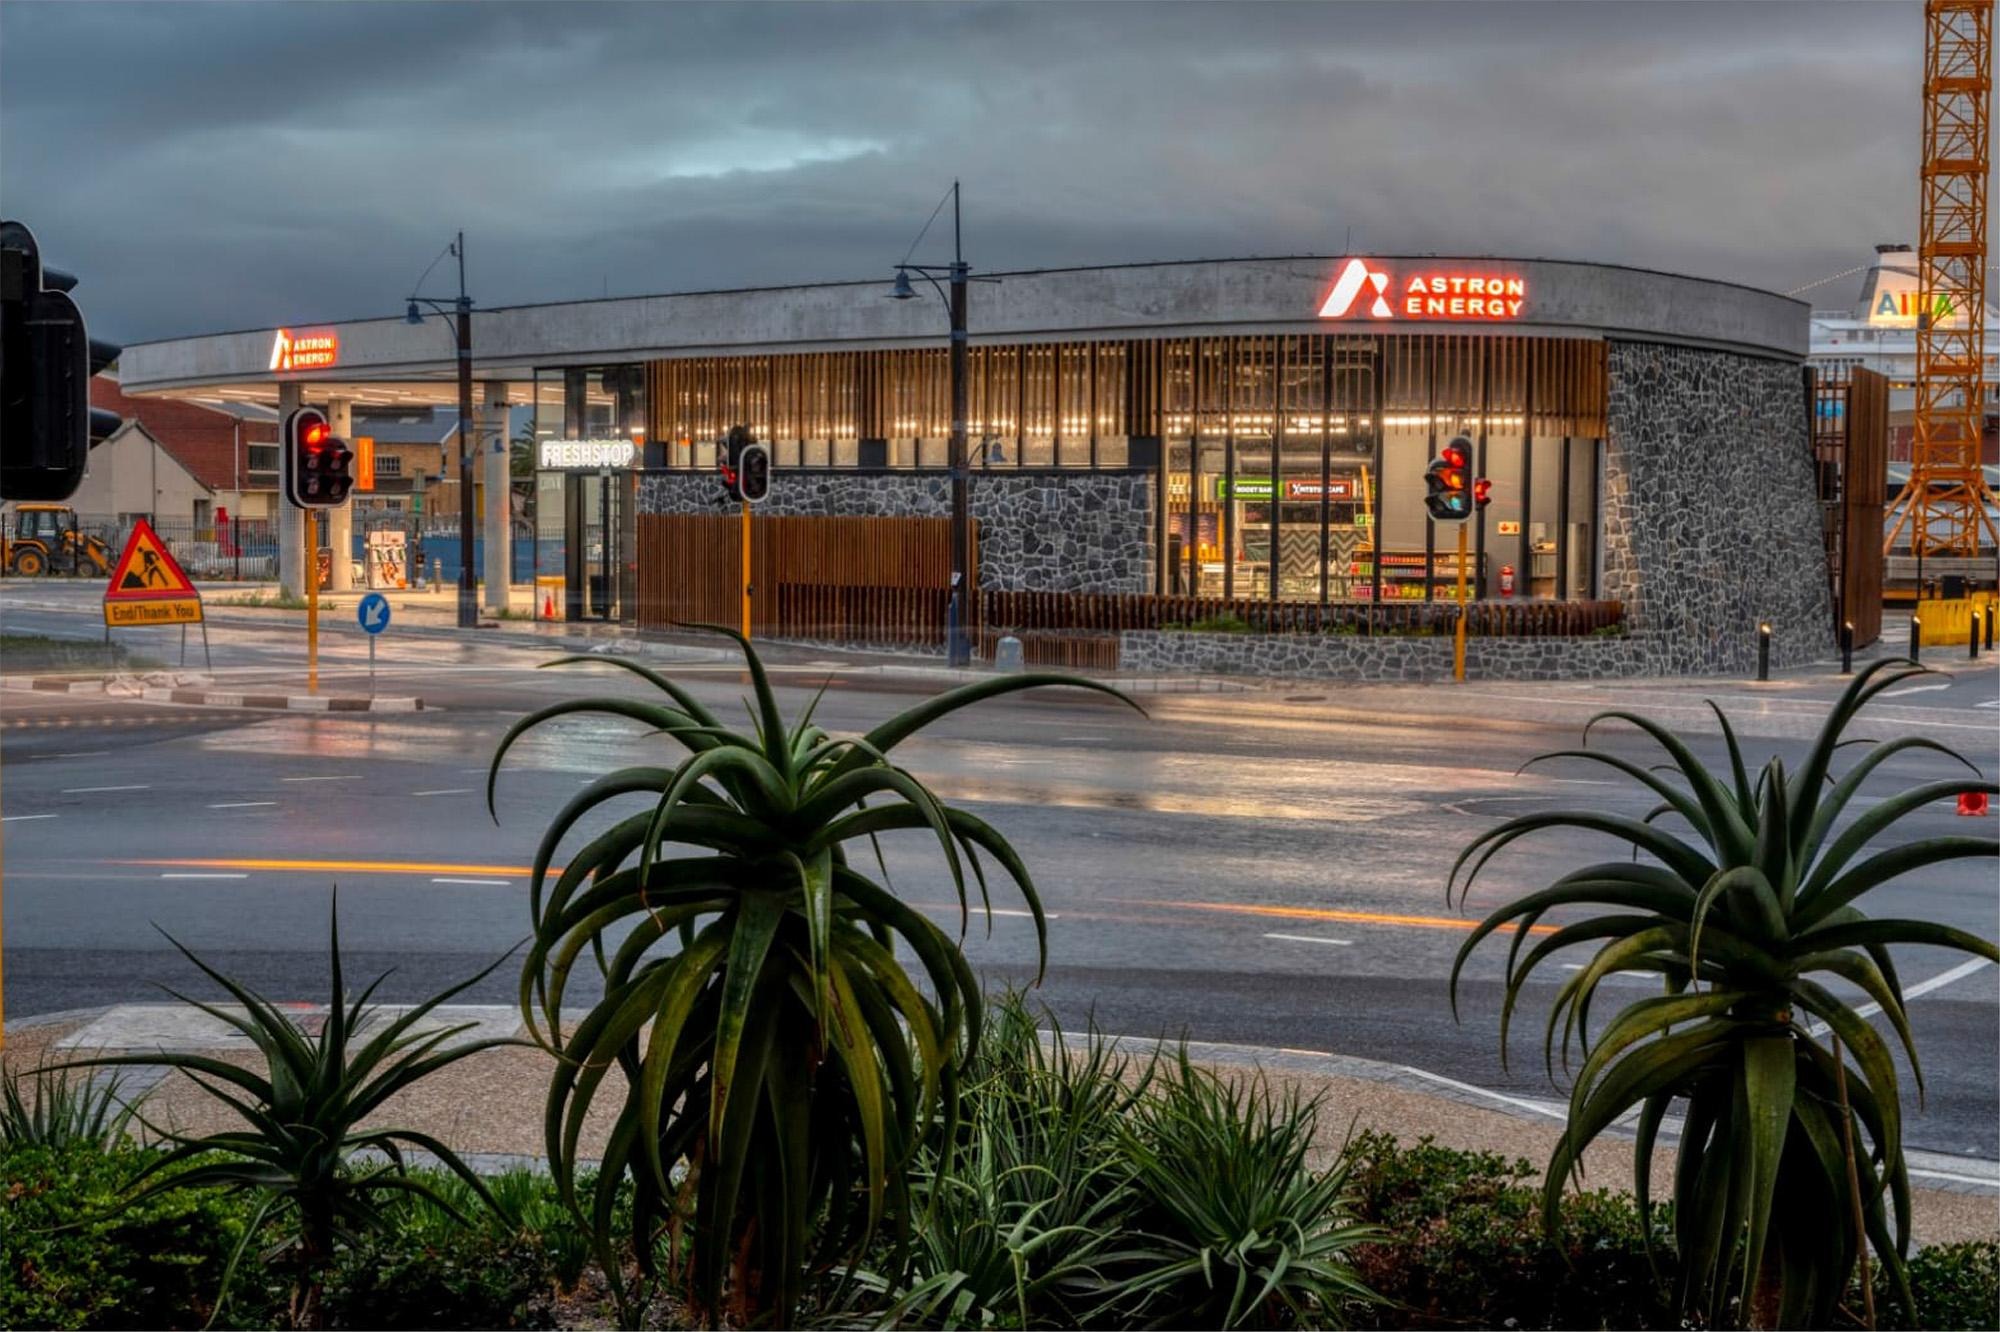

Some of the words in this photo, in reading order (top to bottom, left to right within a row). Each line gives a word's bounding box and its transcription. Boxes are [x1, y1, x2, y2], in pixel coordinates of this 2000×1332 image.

[1407, 277, 1524, 295] ASTRON
[1407, 298, 1523, 315] ENERGY
[294, 337, 334, 350] ASTRON
[294, 352, 334, 365] ENERGY
[541, 440, 634, 466] FRESHSTOP
[113, 604, 169, 621] End/Thank
[174, 603, 194, 617] You
